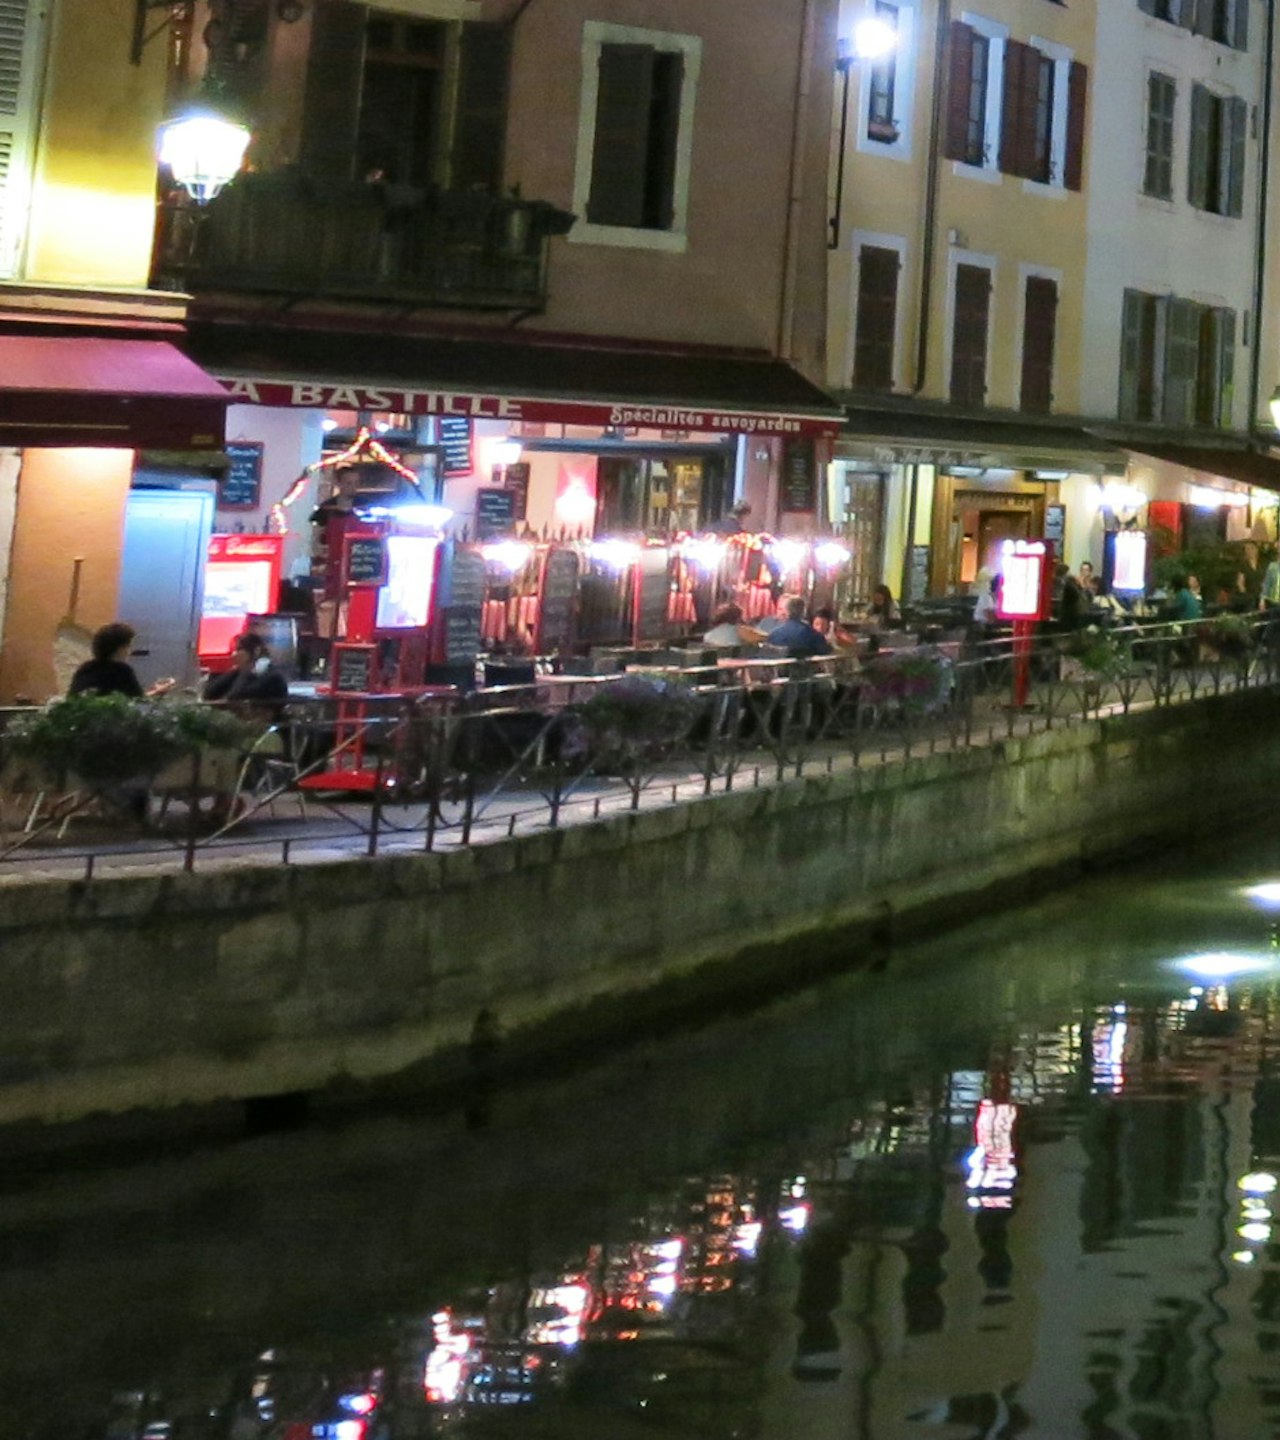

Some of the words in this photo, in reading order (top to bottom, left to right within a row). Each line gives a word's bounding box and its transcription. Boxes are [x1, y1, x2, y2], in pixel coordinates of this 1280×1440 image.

[228, 379, 260, 403] A
[291, 381, 523, 418] BASTILLE
[711, 415, 801, 432] savoyardes
